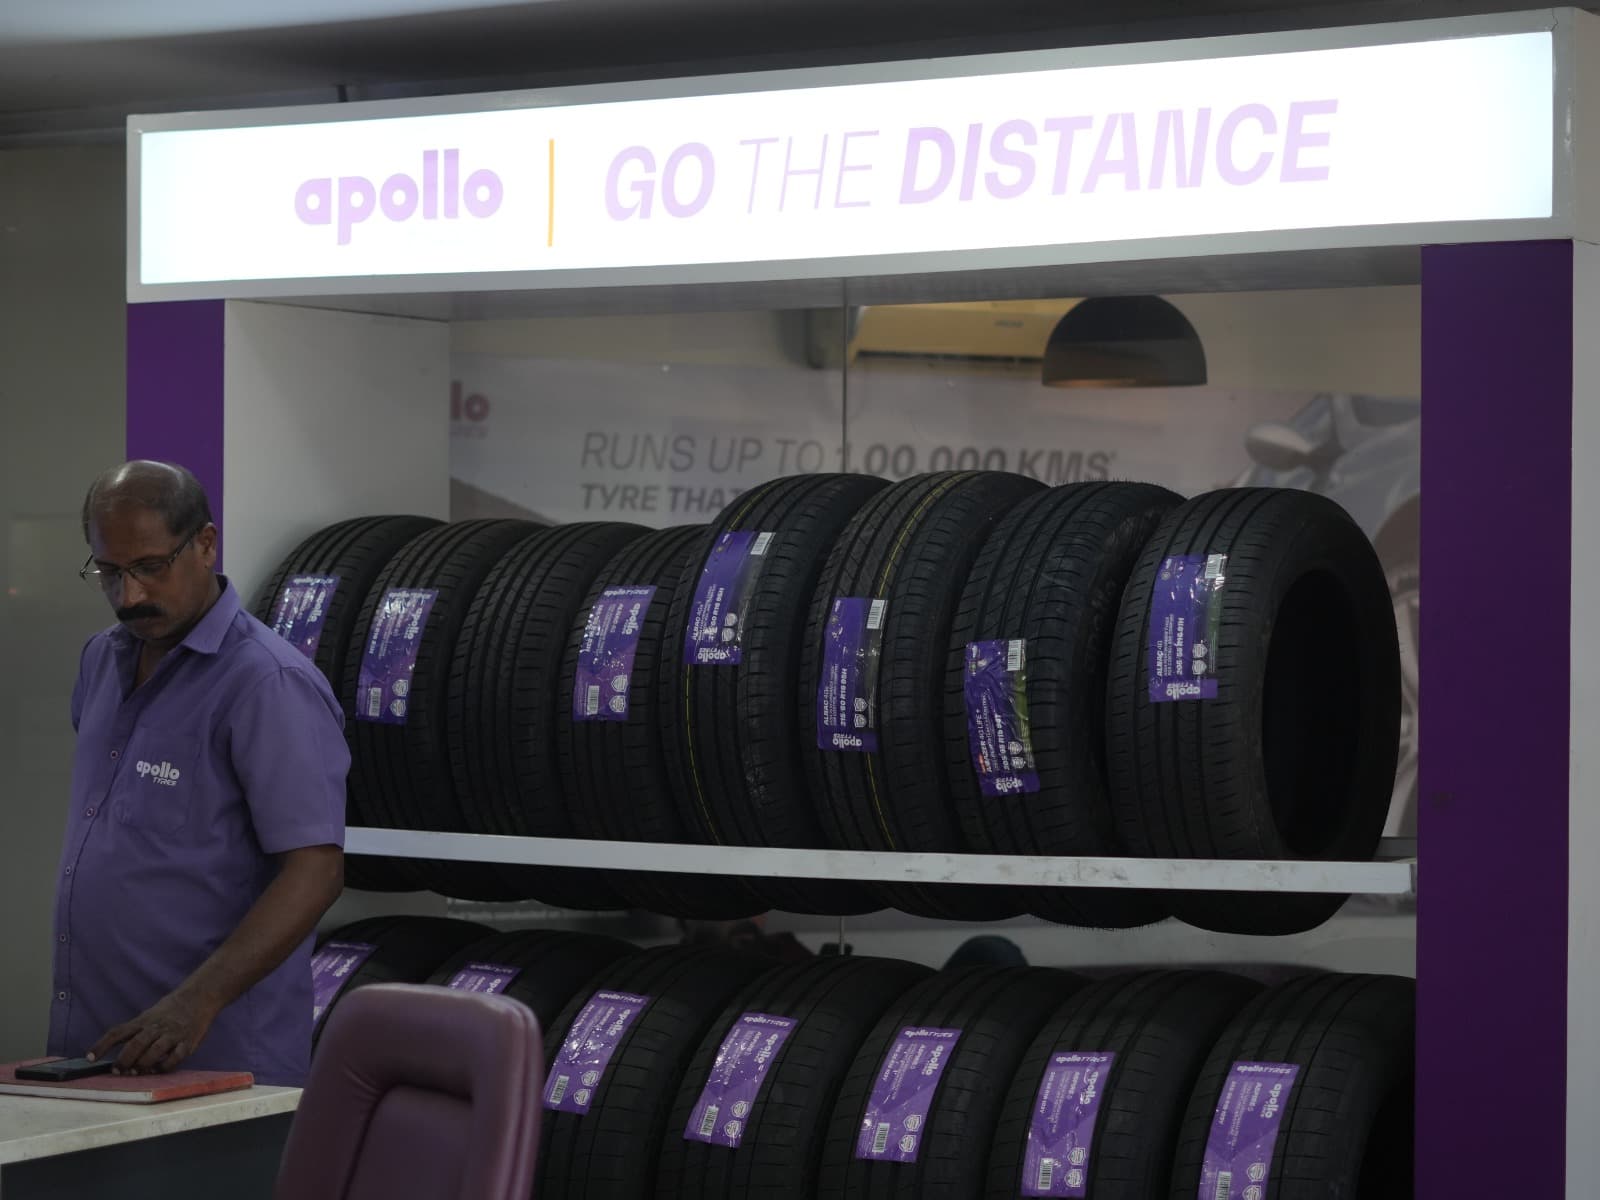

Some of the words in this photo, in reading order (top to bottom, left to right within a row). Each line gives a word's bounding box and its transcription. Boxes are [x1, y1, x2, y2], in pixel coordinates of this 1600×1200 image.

[605, 142, 716, 220] GO
[740, 130, 879, 214] THE
[899, 99, 1338, 204] DISTANCE
[295, 149, 503, 245] apollo
[580, 431, 696, 473] RUNS
[707, 435, 763, 474] UP
[775, 437, 825, 474] TO
[580, 483, 659, 512] TYRE
[407, 608, 423, 640] apollo
[625, 602, 641, 635] apollo
[697, 651, 727, 663] apollo
[1166, 686, 1201, 700] apollo
[832, 737, 862, 749] apollo
[136, 760, 180, 780] apollo
[609, 1009, 632, 1036] apollo
[758, 1033, 779, 1064] apollo
[925, 1045, 944, 1076] apollo
[1265, 1083, 1282, 1118] apollo
